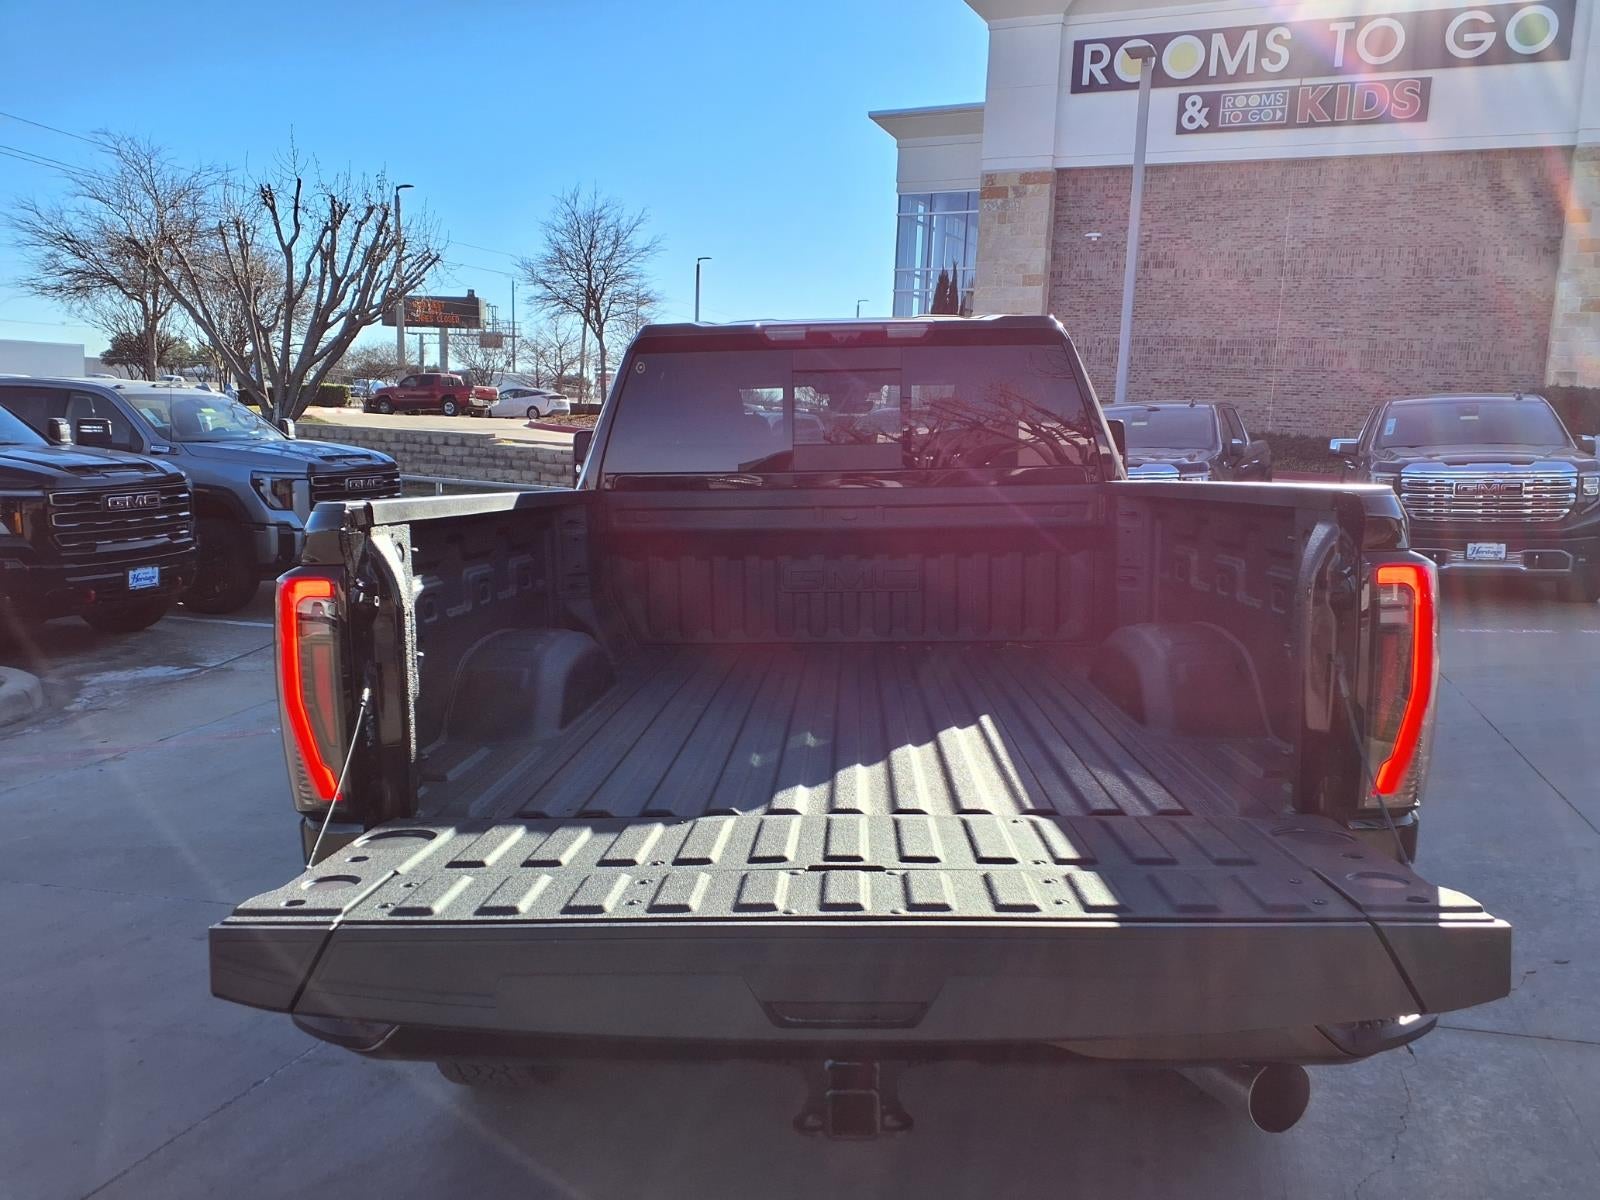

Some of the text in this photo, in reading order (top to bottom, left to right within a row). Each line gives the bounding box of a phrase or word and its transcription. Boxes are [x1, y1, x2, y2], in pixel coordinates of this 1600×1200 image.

[1080, 4, 1560, 86] ROOMS TO GO
[1224, 92, 1284, 109] ROOMS
[1296, 79, 1422, 124] KIDS
[1181, 94, 1210, 131] &
[1224, 109, 1273, 123] TO GO
[436, 315, 460, 323] CLOSED
[349, 478, 384, 490] GMC
[1457, 483, 1521, 494] GMC
[107, 494, 160, 511] GMC
[1469, 545, 1502, 557] Heritage
[785, 569, 919, 591] GMC
